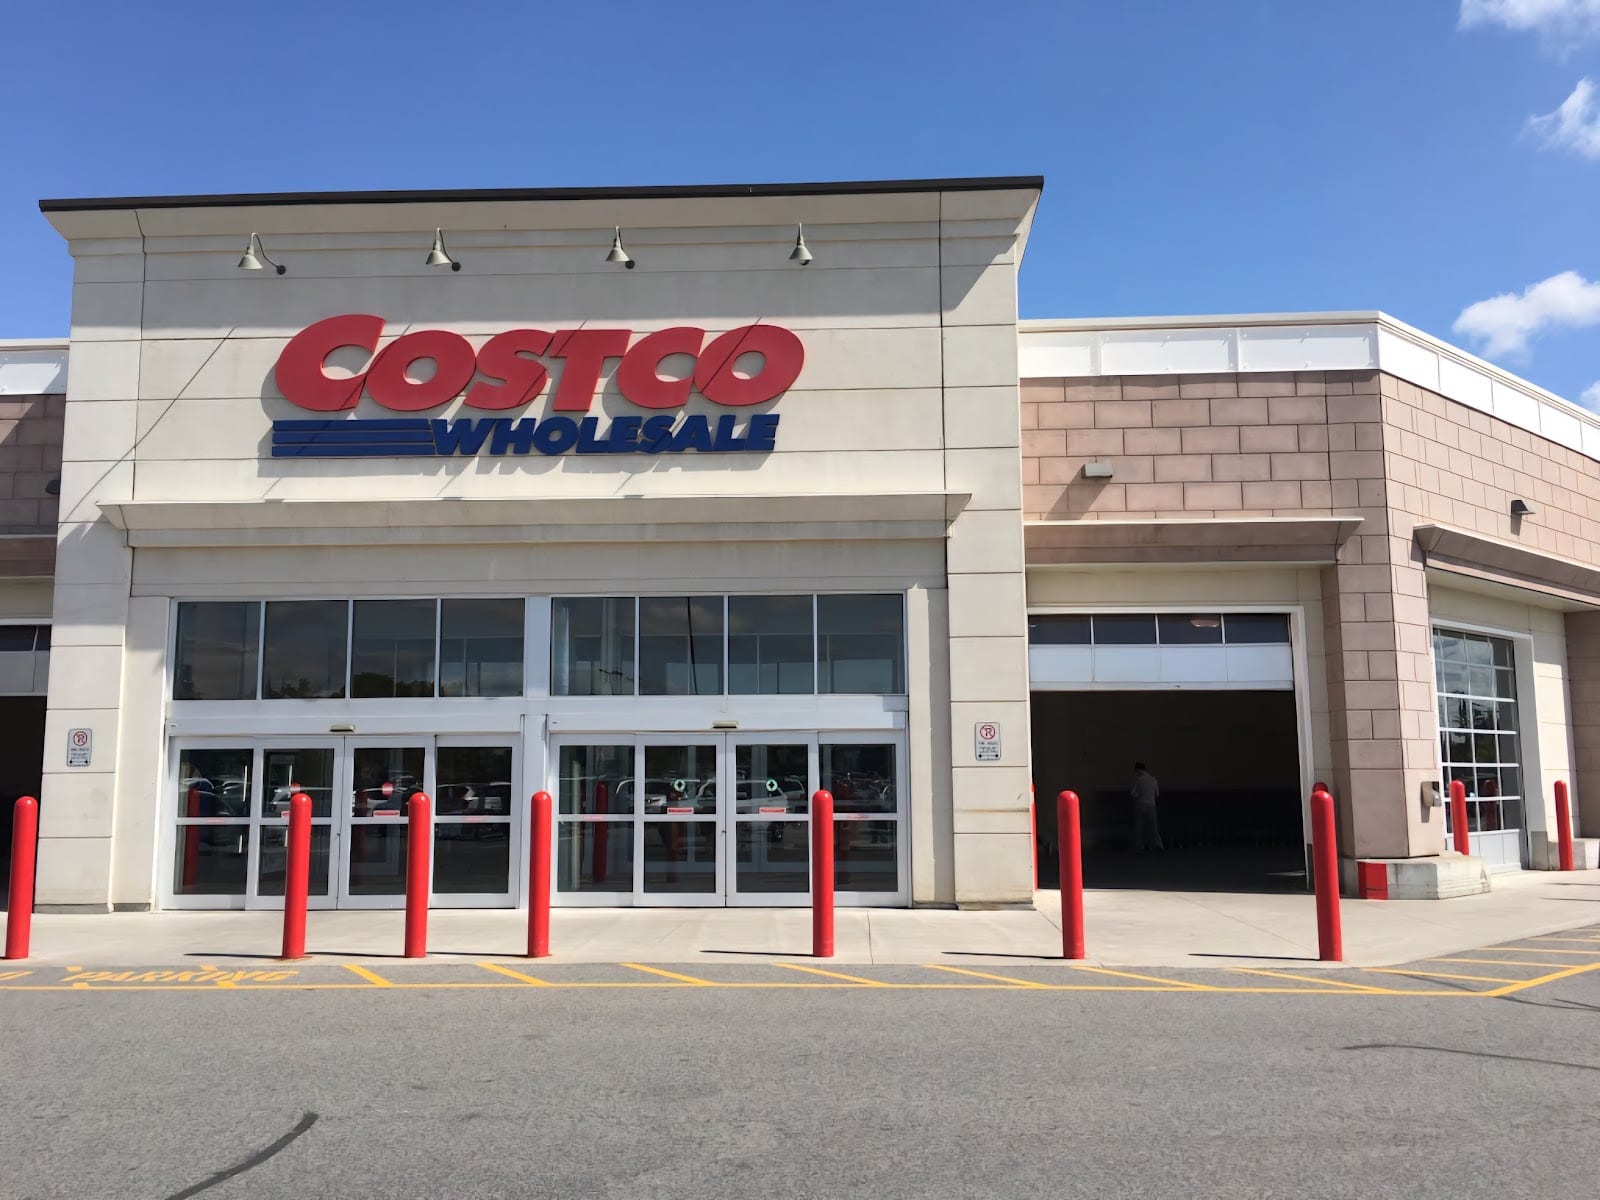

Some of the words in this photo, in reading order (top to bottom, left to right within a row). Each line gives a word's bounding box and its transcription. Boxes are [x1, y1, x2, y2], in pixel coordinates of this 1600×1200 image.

[276, 314, 804, 412] COSTCO
[435, 415, 780, 455] WHOLESALE
[60, 970, 300, 982] PARKING
